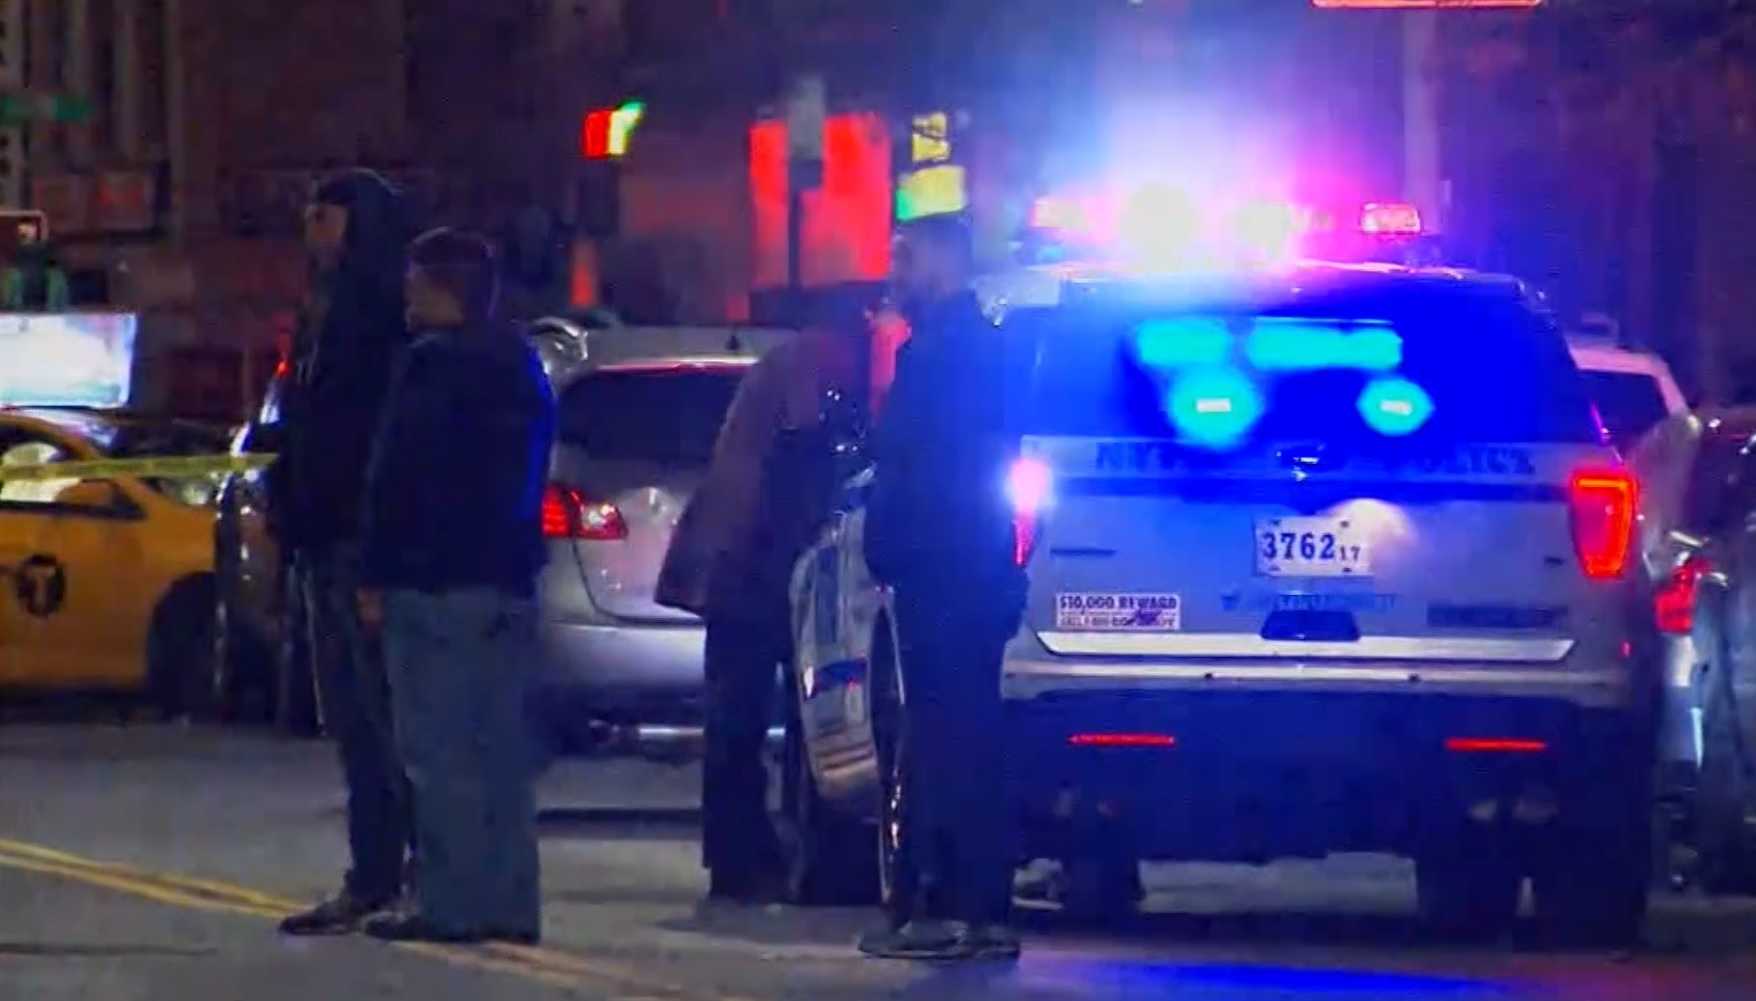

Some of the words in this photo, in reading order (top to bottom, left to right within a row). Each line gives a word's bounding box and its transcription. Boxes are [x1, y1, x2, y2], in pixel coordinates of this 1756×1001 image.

[1262, 532, 1335, 560] 3762
[1340, 545, 1361, 560] 17
[1060, 596, 1114, 614] $10,000
